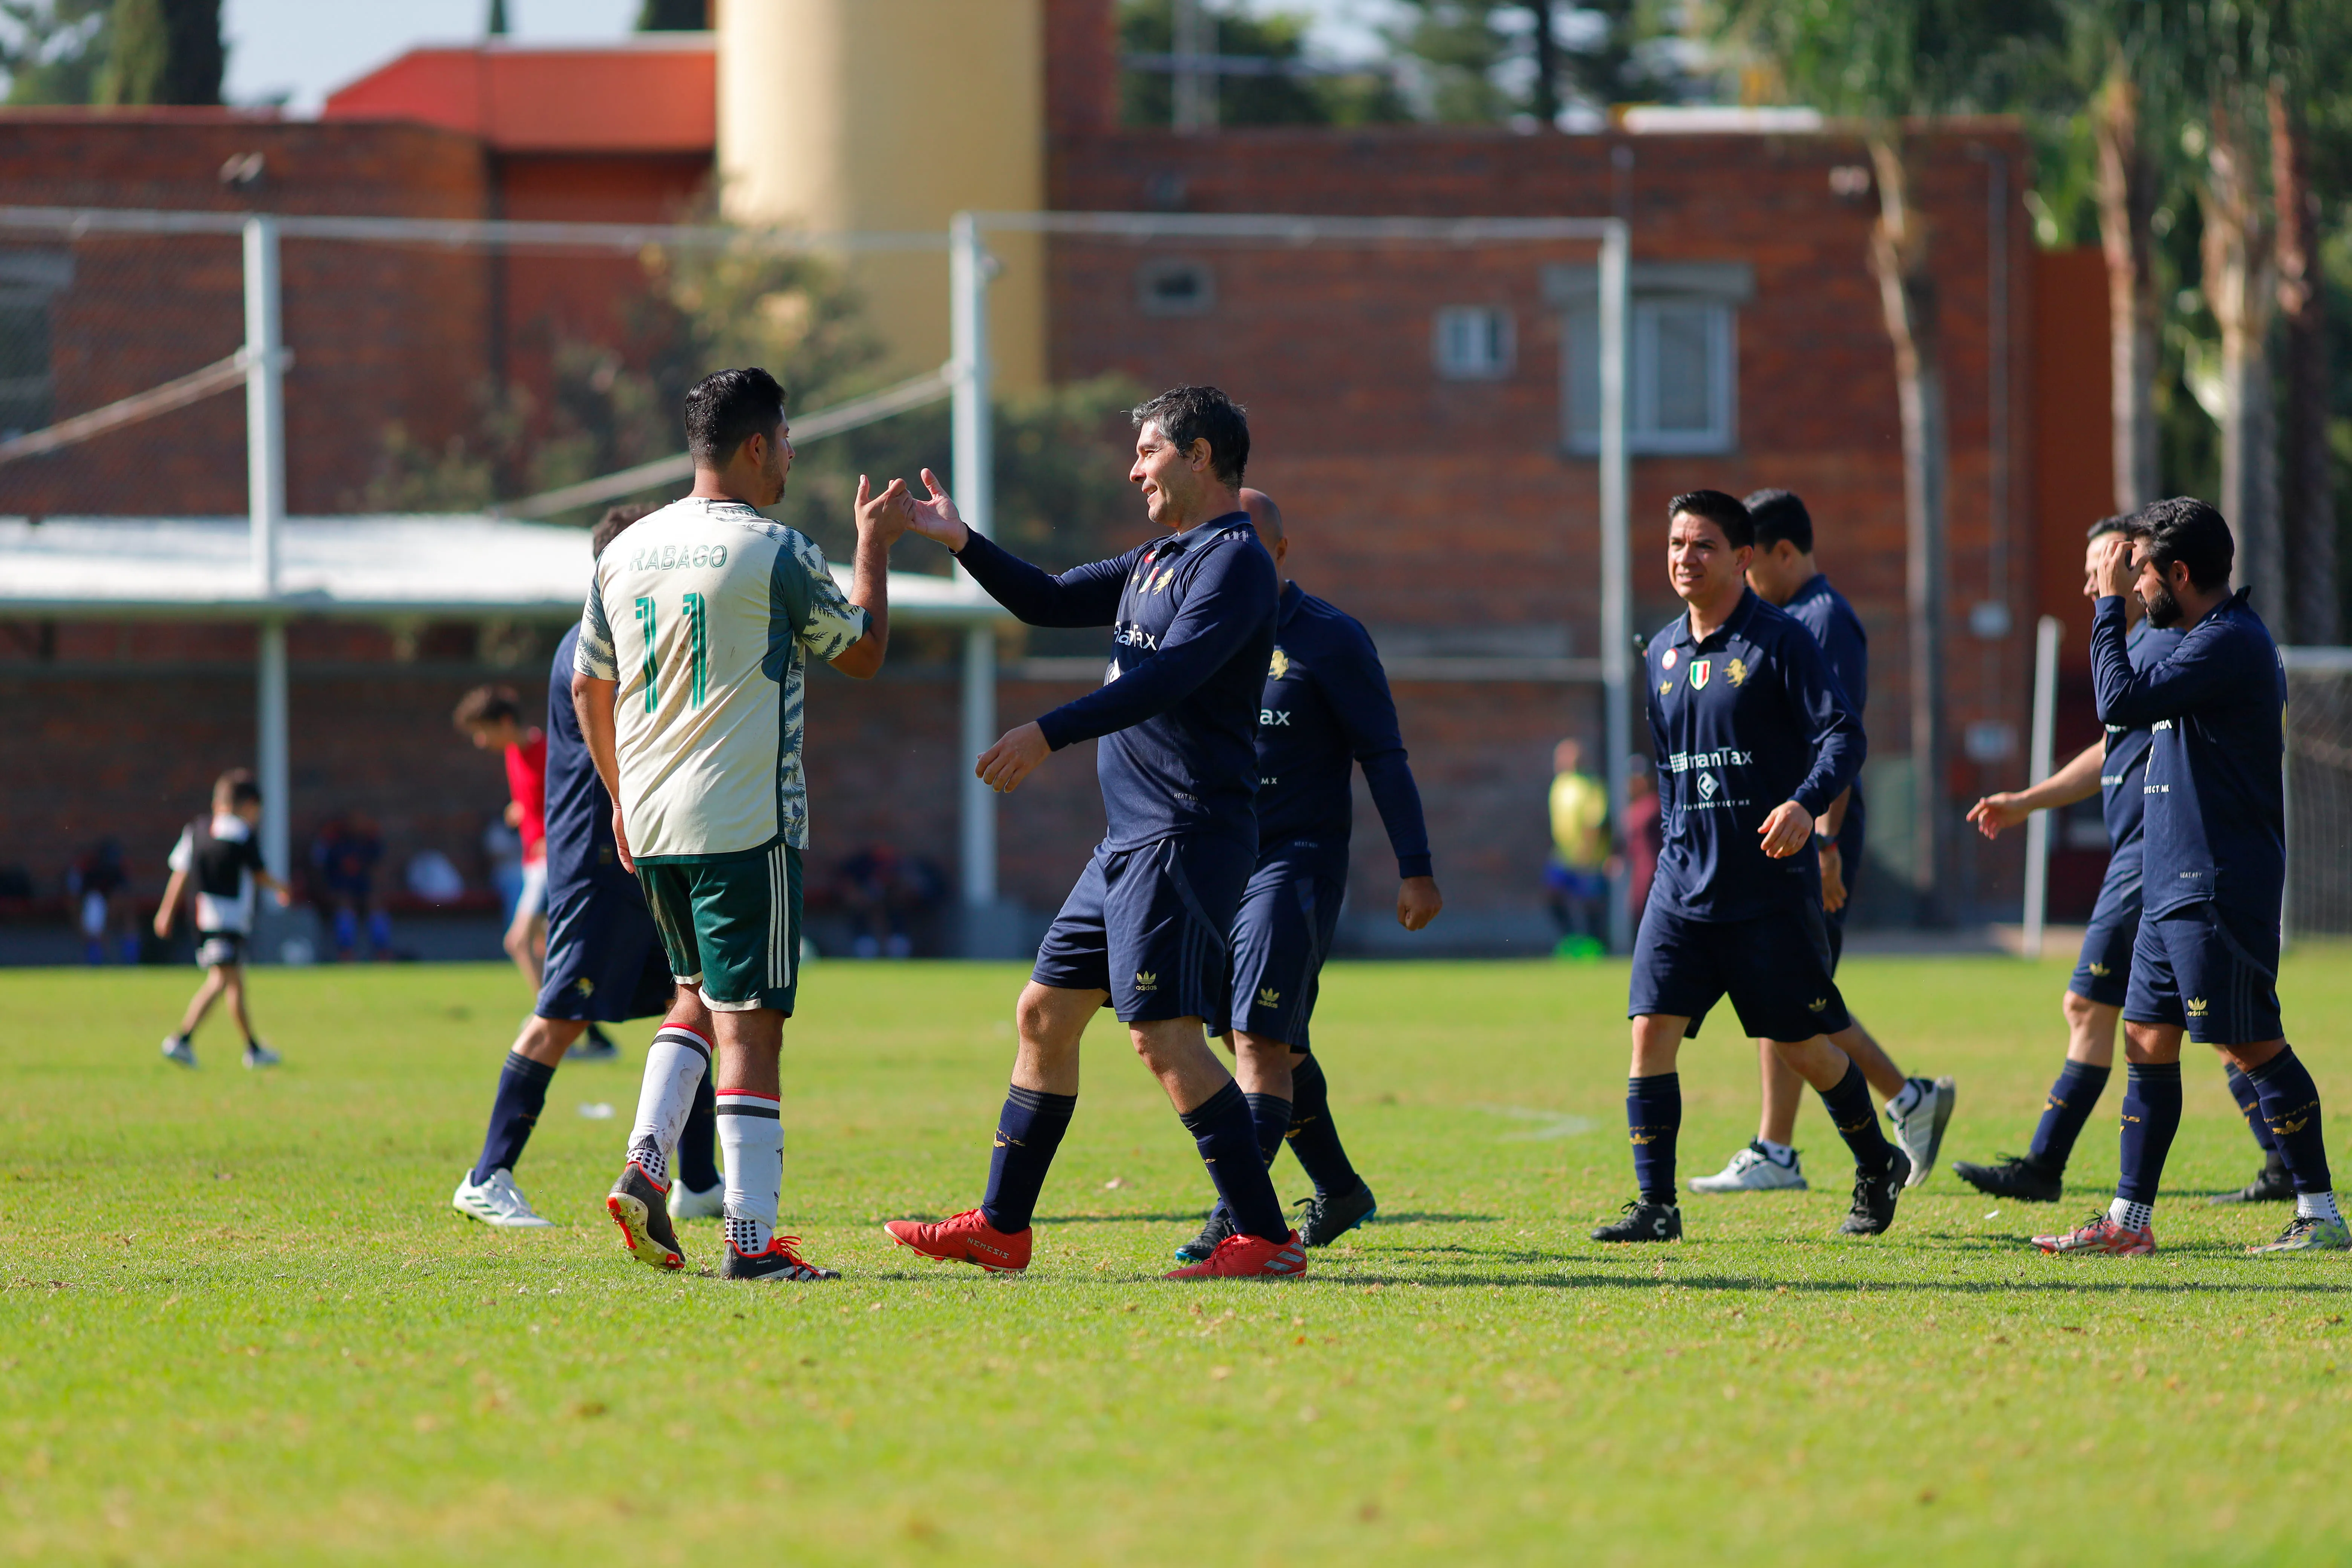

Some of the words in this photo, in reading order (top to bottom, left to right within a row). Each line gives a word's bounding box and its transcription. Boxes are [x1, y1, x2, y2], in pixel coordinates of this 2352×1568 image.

[629, 545, 728, 571] RABAGO
[635, 592, 706, 714] 11
[1260, 709, 1291, 726] ax
[1257, 999, 1279, 1009] adidas
[967, 1237, 1010, 1259] NEMESIS
